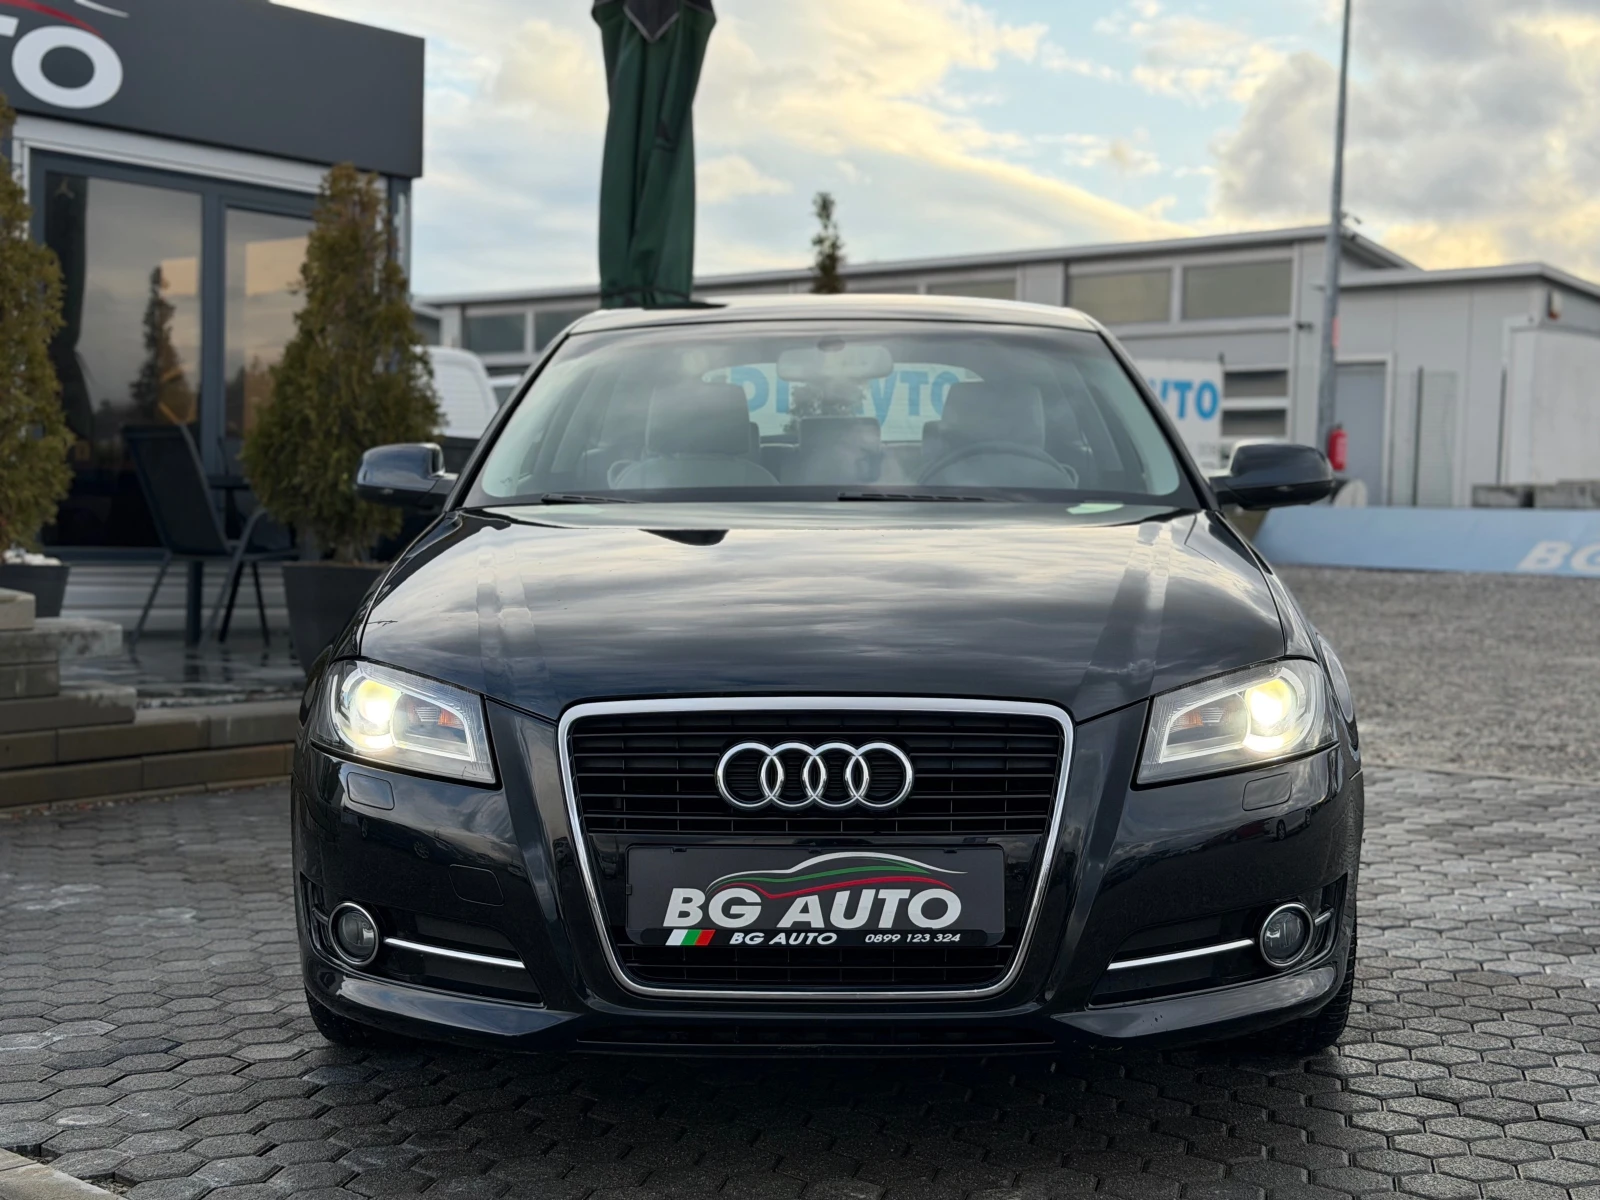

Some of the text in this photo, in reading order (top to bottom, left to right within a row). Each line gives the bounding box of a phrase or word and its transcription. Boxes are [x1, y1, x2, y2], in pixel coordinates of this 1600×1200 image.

[0, 14, 123, 109] O
[663, 887, 962, 929] BG AUTO
[729, 932, 838, 945] BG AUTO
[865, 933, 961, 943] 0899 123 324
